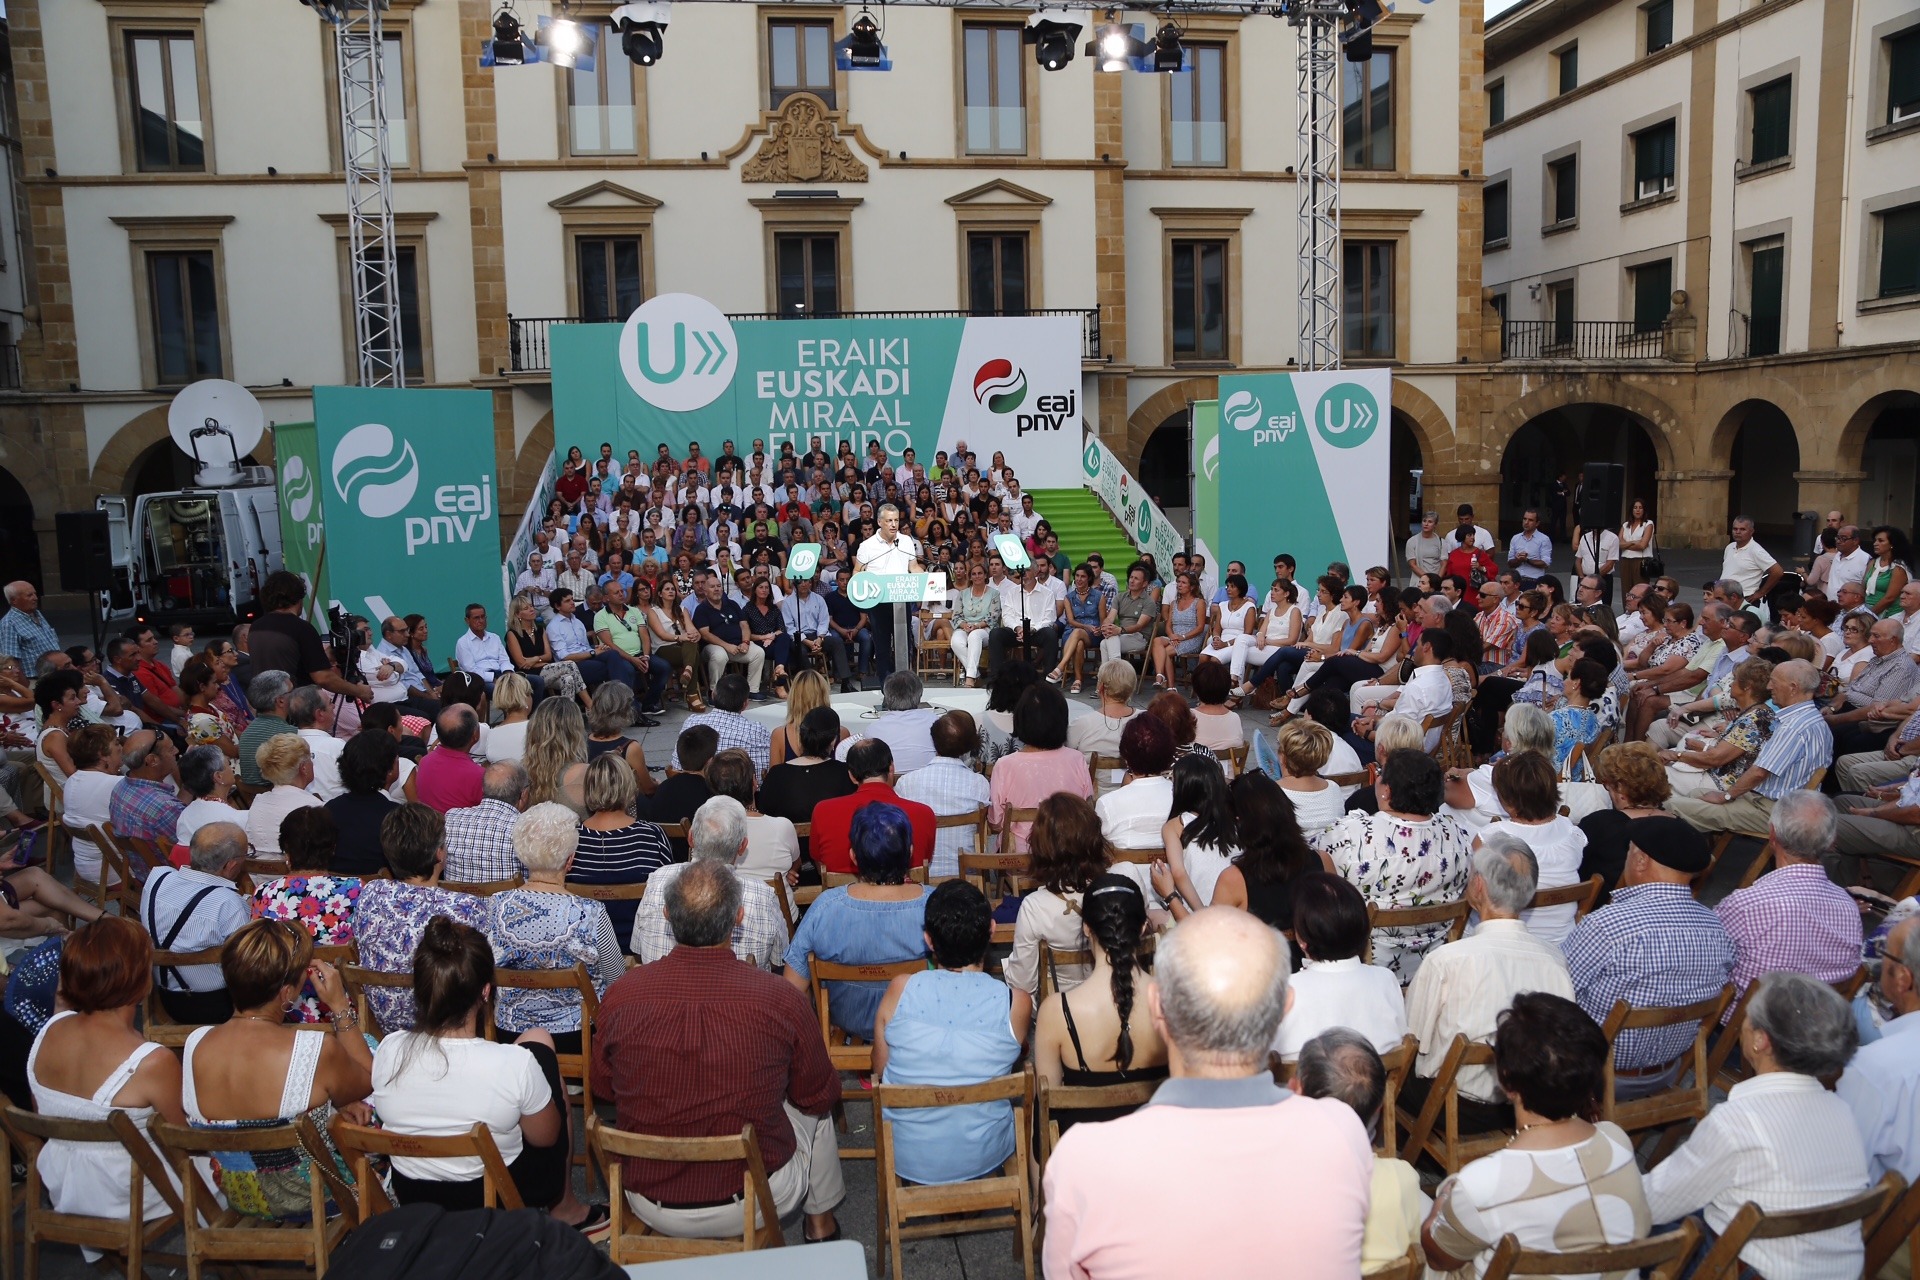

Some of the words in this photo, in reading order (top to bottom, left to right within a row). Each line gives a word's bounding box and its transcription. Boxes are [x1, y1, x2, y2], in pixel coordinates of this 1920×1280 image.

[637, 322, 686, 384] U
[798, 338, 908, 366] ERAIKI
[757, 368, 909, 398] EUSKADI
[769, 400, 860, 429] MIRA
[868, 399, 910, 426] AL
[1037, 389, 1075, 418] eaj
[1017, 414, 1065, 437] pnv
[1268, 411, 1296, 432] eaj
[1254, 429, 1288, 446] pnv
[435, 474, 491, 520] eaj
[405, 515, 477, 555] pnv
[895, 575, 919, 583] ERAIKI
